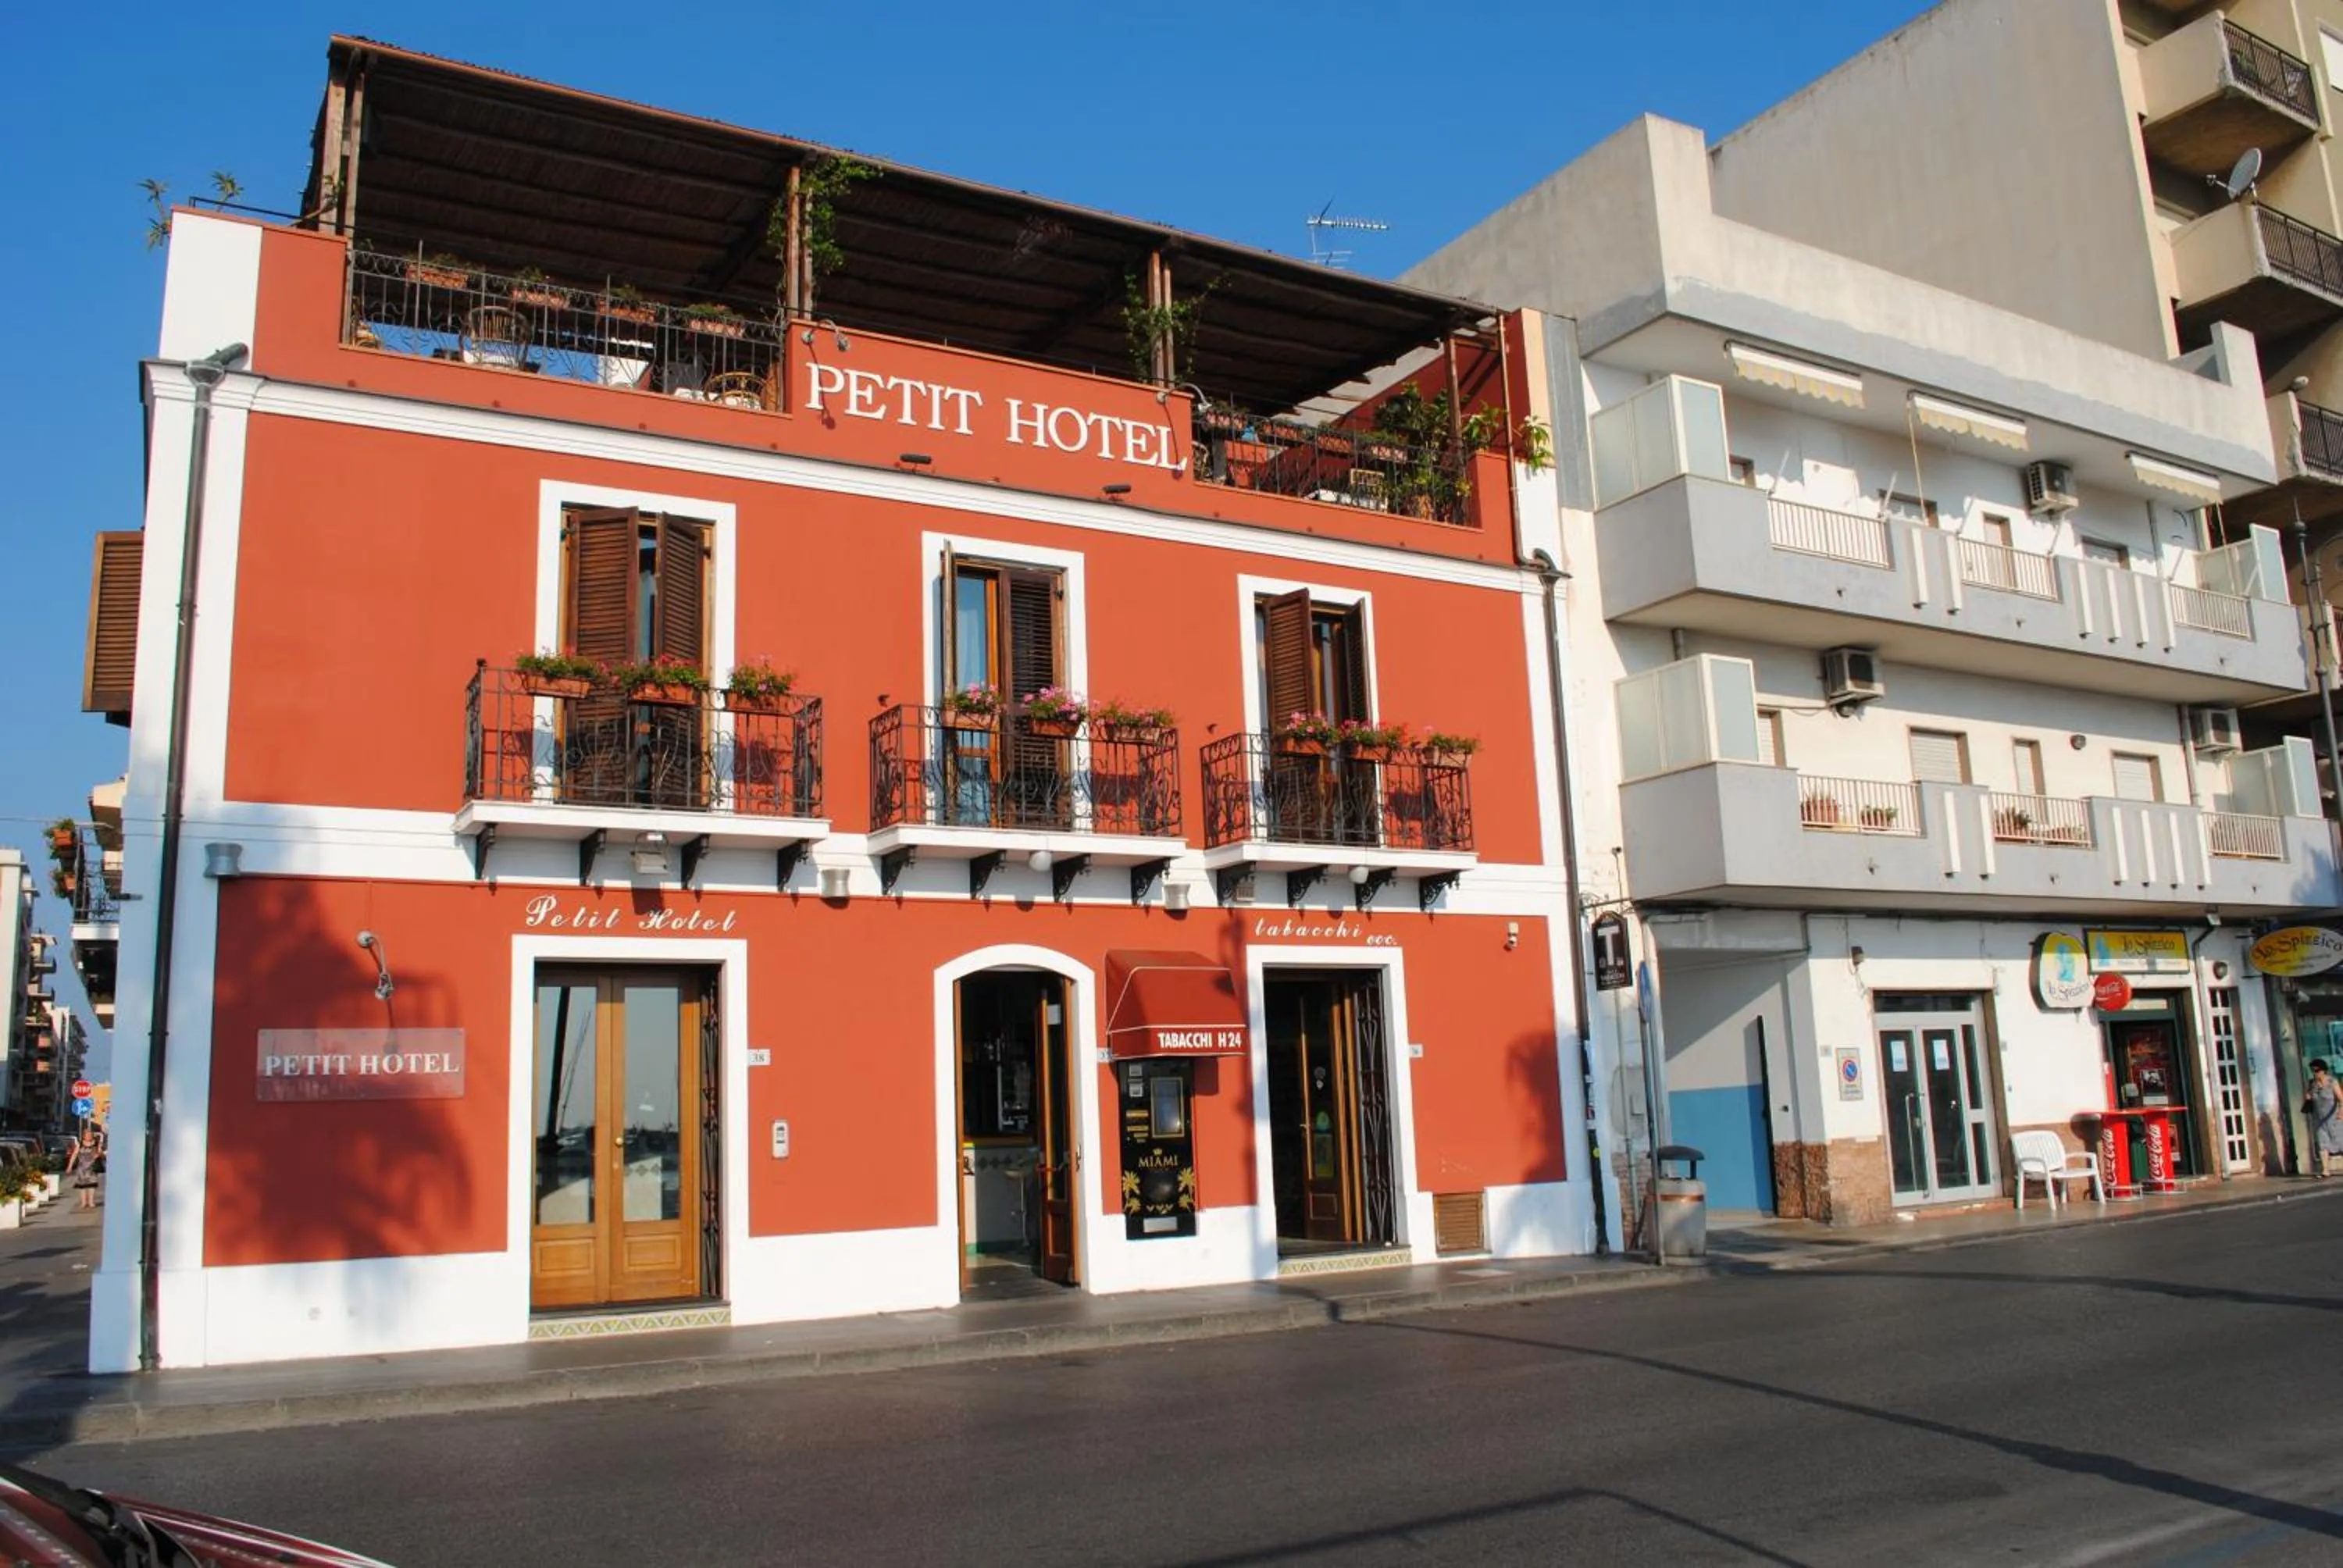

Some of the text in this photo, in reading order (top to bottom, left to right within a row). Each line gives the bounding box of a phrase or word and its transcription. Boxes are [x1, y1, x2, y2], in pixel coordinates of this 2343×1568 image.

[804, 362, 1187, 471] PETIT HOTEL
[525, 894, 736, 932] Petit Hotel
[1254, 918, 1362, 938] tabacchi
[1597, 925, 1621, 966] T
[1157, 1032, 1213, 1048] TABACCHI
[265, 1053, 460, 1077] PETIT HOTEL
[1138, 1154, 1179, 1168] MIAMI
